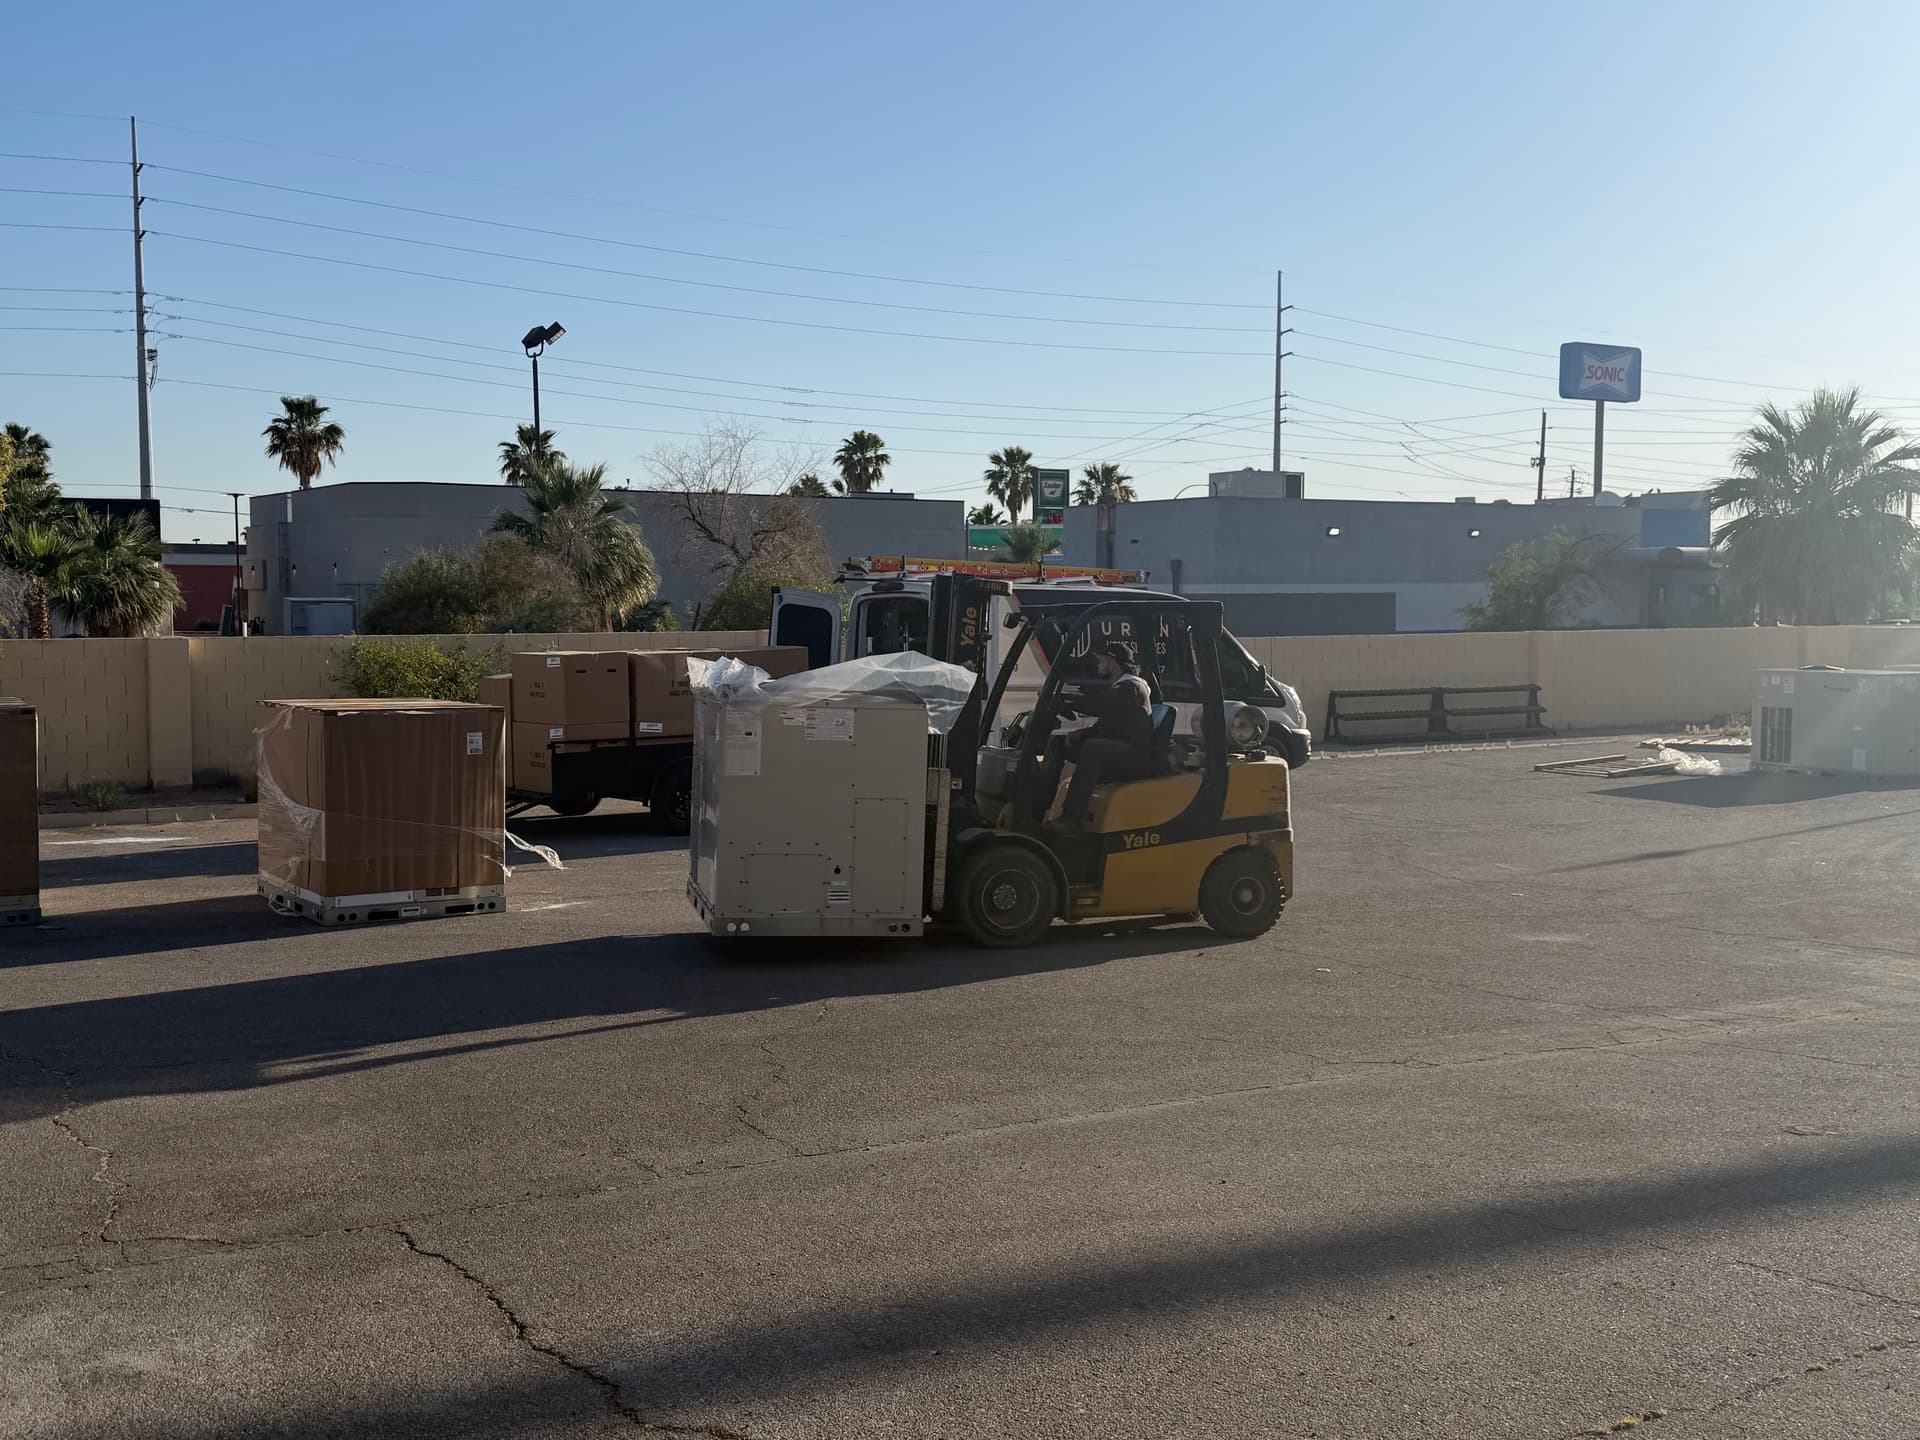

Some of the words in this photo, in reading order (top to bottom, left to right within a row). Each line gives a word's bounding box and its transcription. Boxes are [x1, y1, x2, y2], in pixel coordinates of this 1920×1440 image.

[1584, 364, 1625, 383] SONIC
[960, 607, 977, 647] Yale
[1123, 832, 1161, 849] Yale
